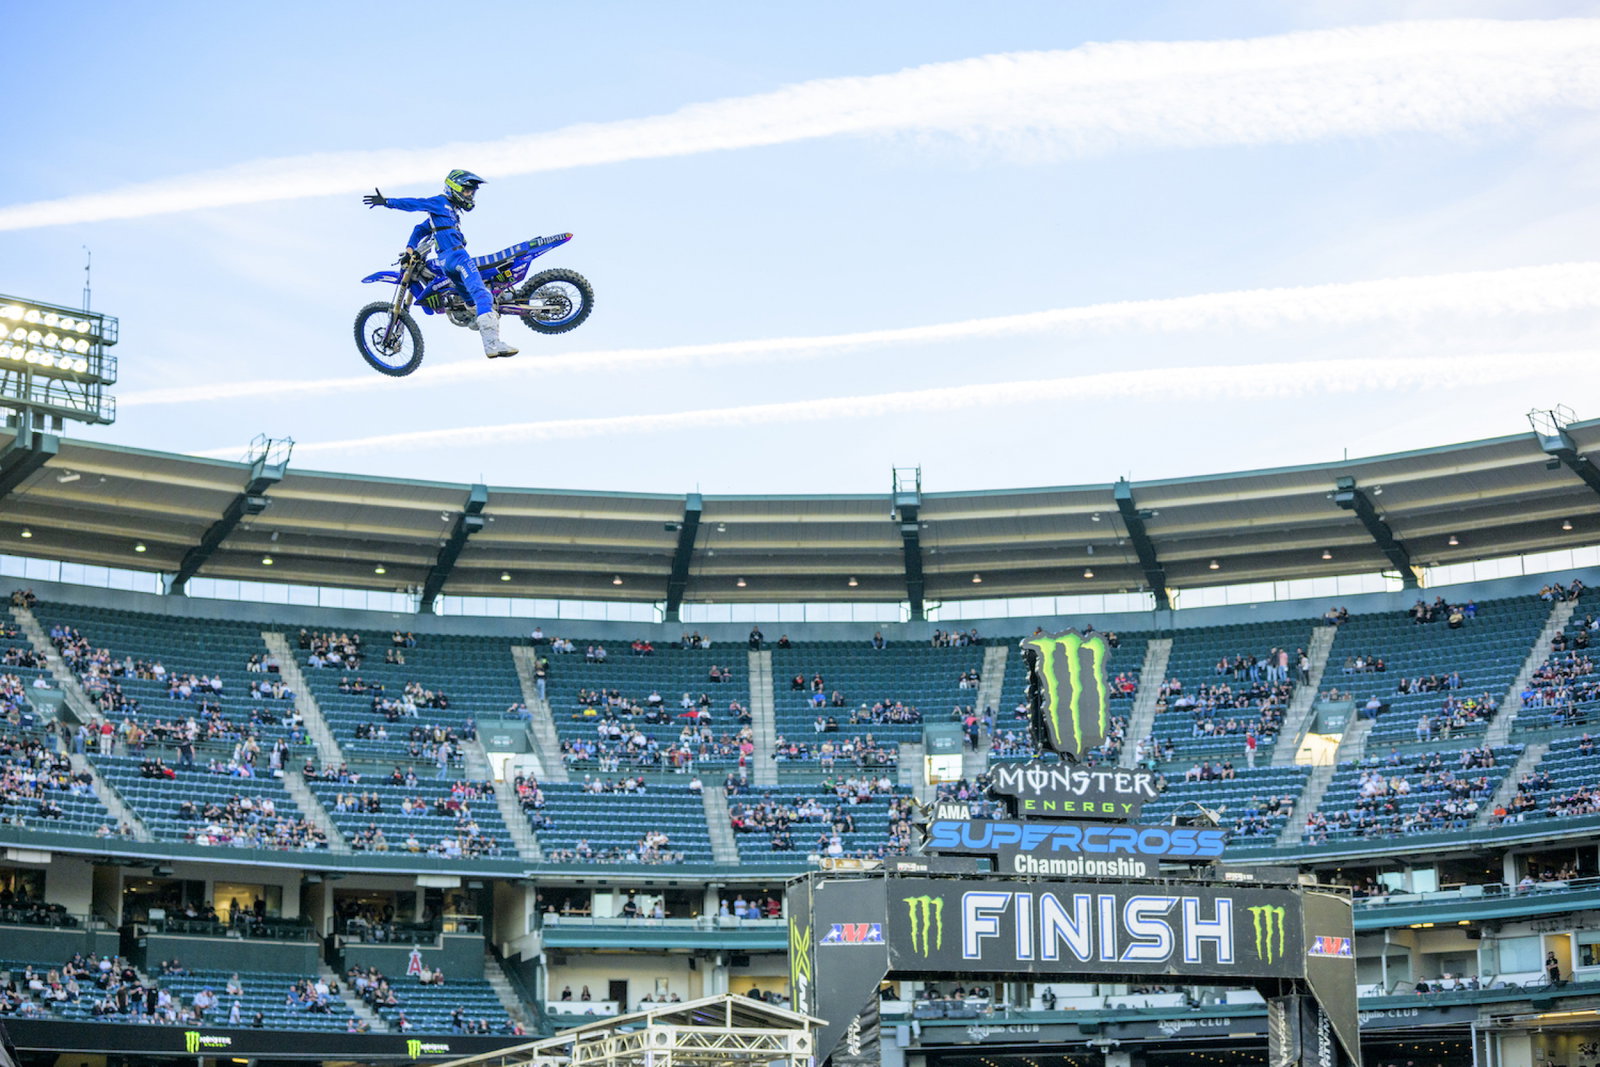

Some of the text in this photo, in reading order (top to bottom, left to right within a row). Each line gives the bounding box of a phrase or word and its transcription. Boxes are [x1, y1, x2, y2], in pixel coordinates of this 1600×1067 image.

[999, 764, 1157, 797] MONSTER
[937, 804, 971, 820] AMA
[1025, 800, 1133, 813] ENERGY
[928, 821, 1227, 856] SUPERCROSS
[1014, 854, 1147, 878] Championship
[819, 923, 885, 944] AMA
[961, 891, 1235, 964] FINISH
[1308, 935, 1353, 957] AMA
[406, 949, 422, 976] A
[1200, 1018, 1231, 1027] CLUB
[1388, 1008, 1419, 1018] CLUB
[1009, 1025, 1040, 1033] CLUB
